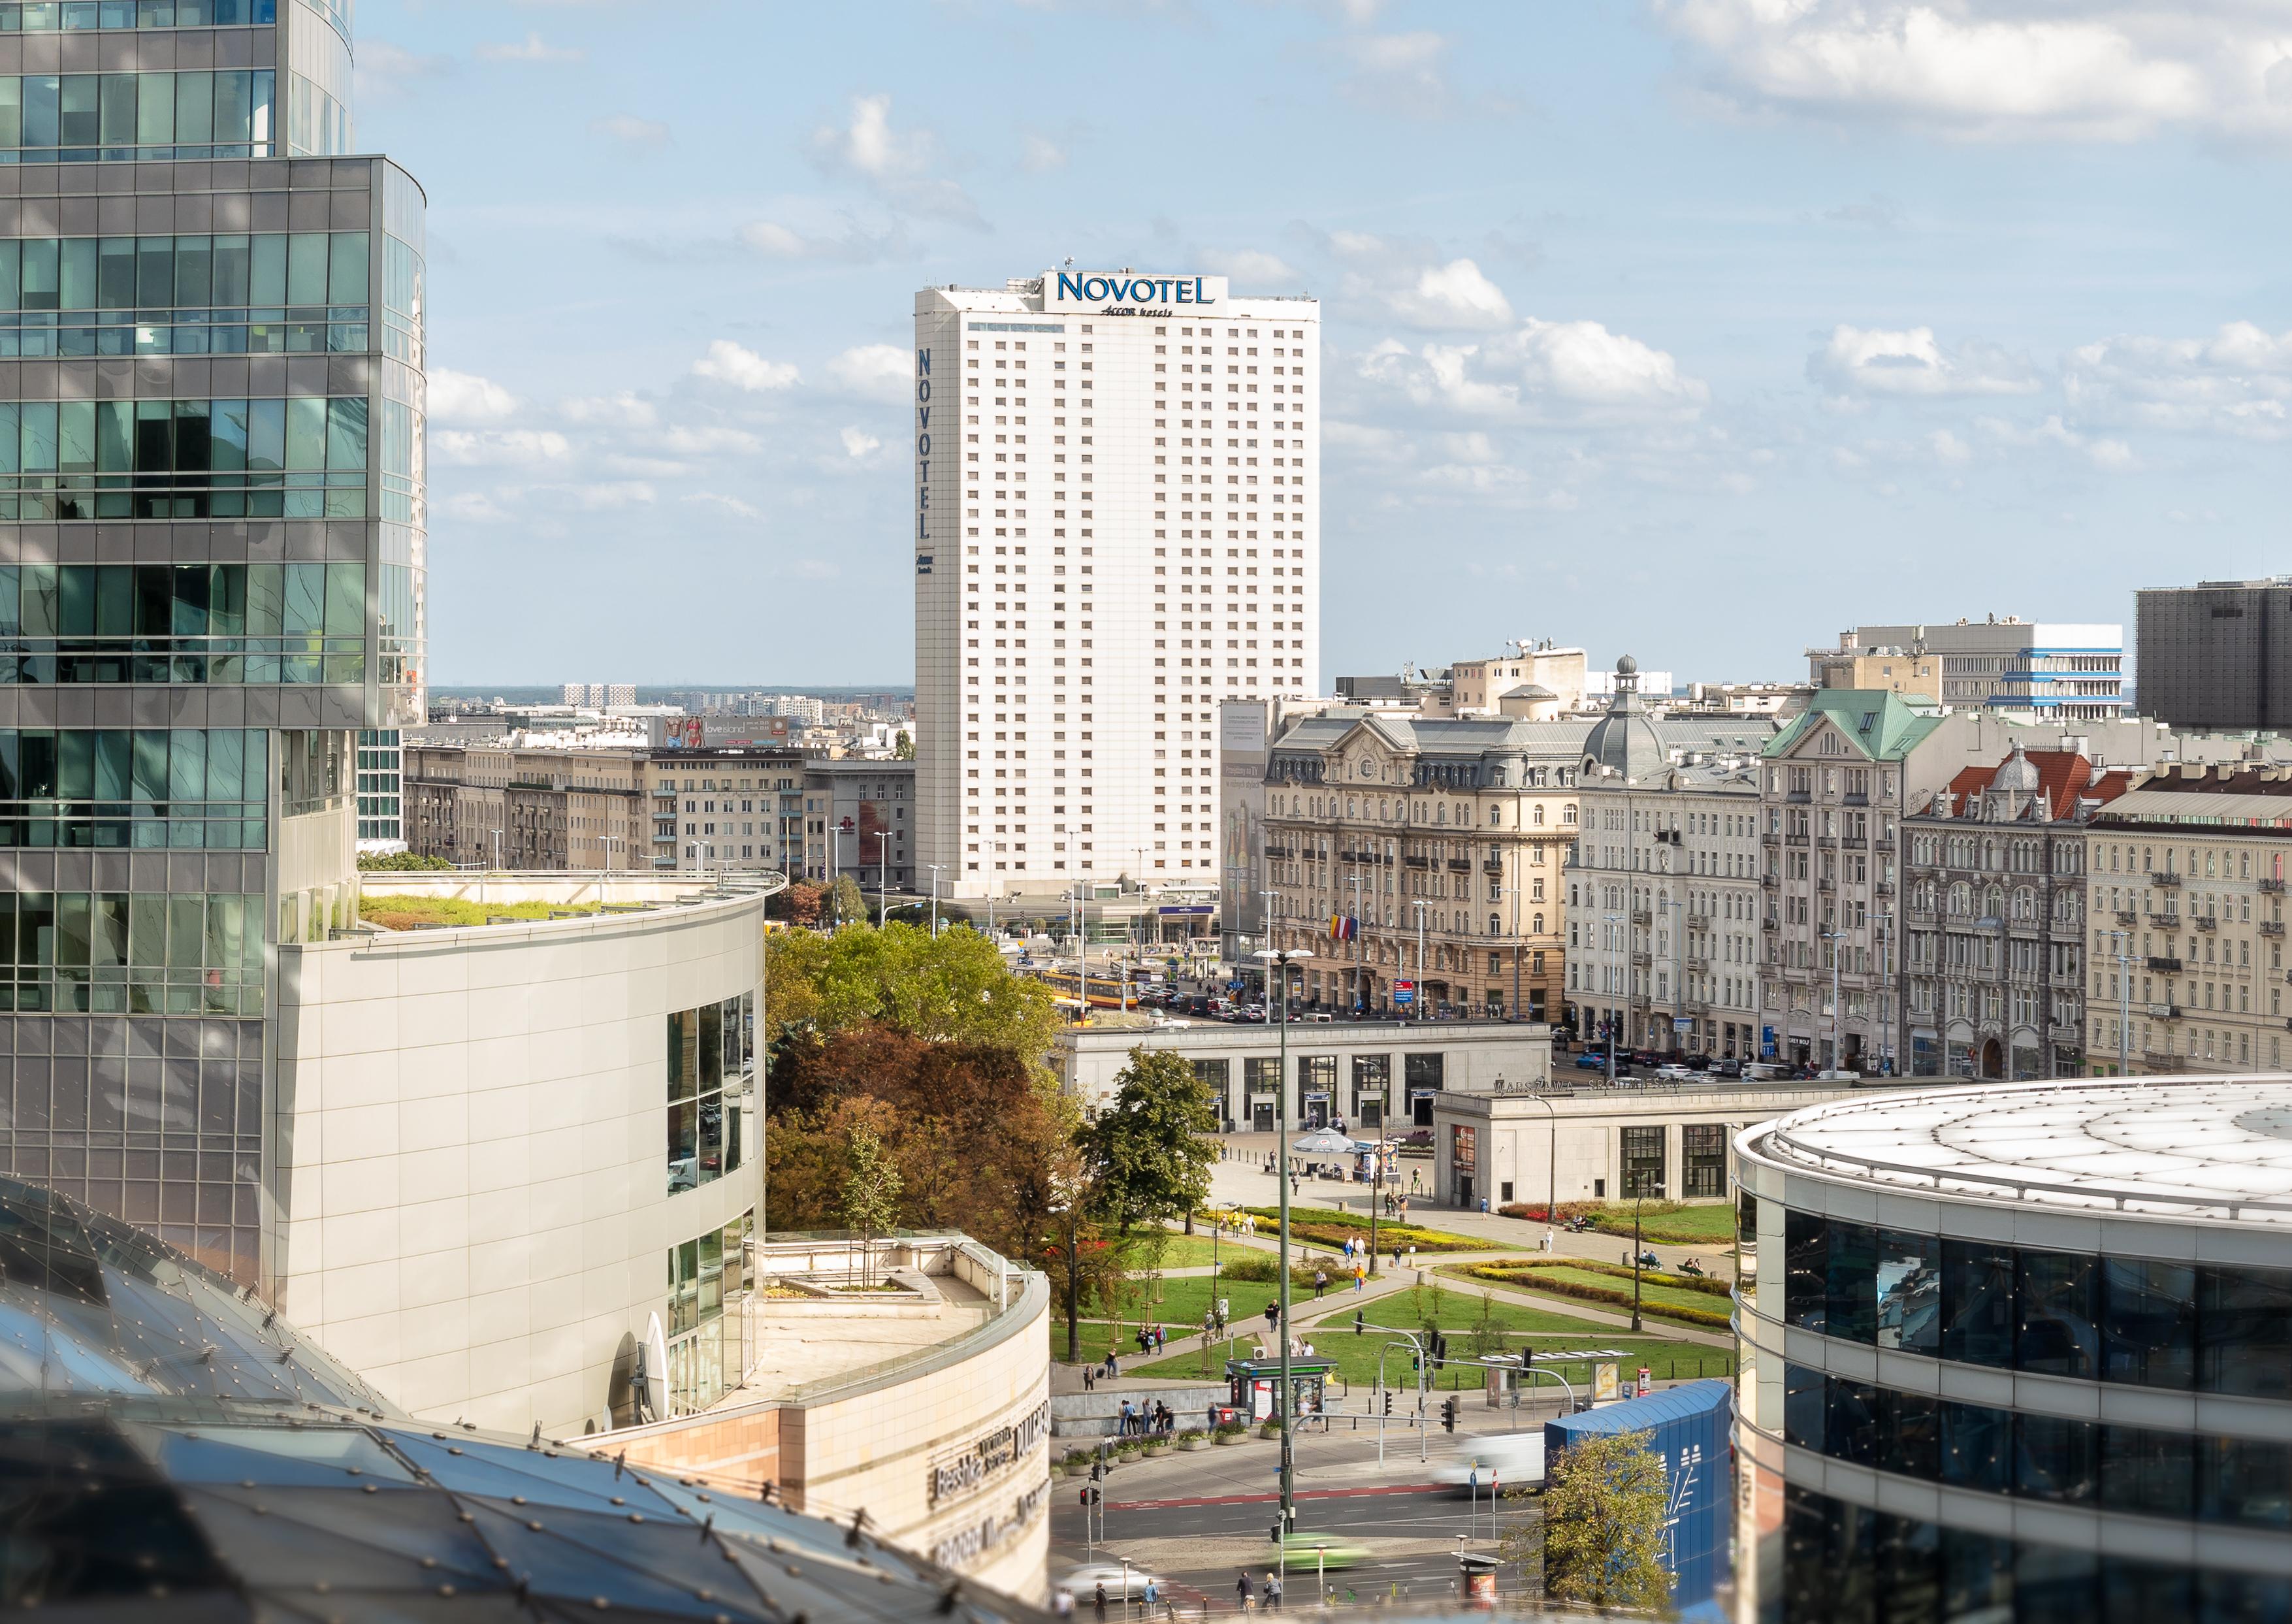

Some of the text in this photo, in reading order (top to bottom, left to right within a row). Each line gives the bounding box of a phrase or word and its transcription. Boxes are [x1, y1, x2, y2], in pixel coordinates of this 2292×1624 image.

[1057, 272, 1216, 304] NOVOTEL
[1138, 308, 1173, 317] hotels
[918, 348, 931, 540] NOVOTEL
[705, 721, 745, 733] love island
[1493, 1078, 1574, 1093] WARSZAWA
[935, 1454, 982, 1501] Bershka
